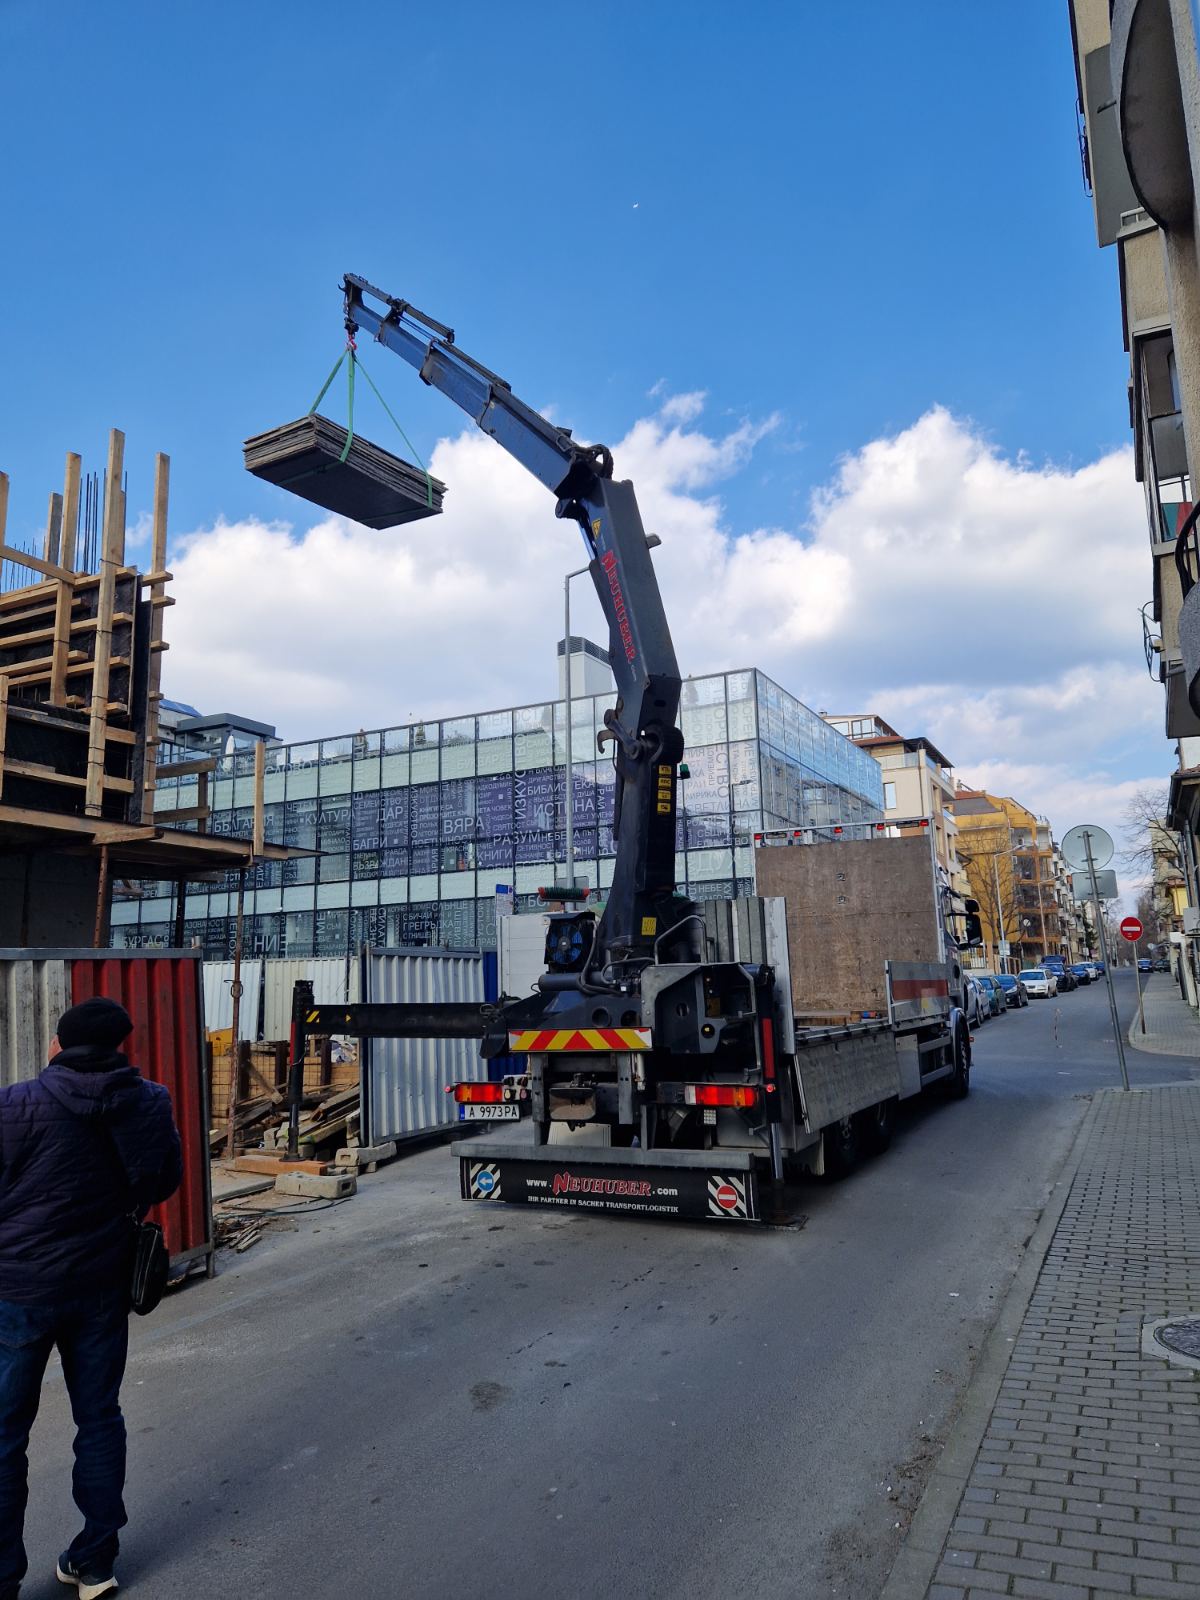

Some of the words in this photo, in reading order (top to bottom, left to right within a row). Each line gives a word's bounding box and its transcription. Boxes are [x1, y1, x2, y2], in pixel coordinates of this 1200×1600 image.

[601, 549, 637, 663] NEUHUBER
[527, 780, 597, 796] БИБЛИОЕКА
[305, 808, 356, 826] КУЛТУРА
[376, 806, 403, 824] ДАР
[410, 786, 419, 839] ИЗКУСТВО
[214, 814, 275, 833] БЪЛГАЯ
[443, 816, 485, 834] ВЯРА
[353, 838, 388, 850] БАГРИ
[493, 831, 540, 847] РАЗУМ
[540, 830, 581, 843] НЕБЕА
[477, 848, 512, 862] КНИГИ
[698, 883, 723, 894] НЕБЕ
[431, 901, 468, 912] СЛЪНЦЕ
[468, 1105, 476, 1118] A
[527, 1195, 540, 1203] IHR
[540, 1196, 569, 1205] PARTNER
[578, 1199, 604, 1208] SACHEN
[605, 1201, 679, 1213] TRANSPORTLOGISTIK
